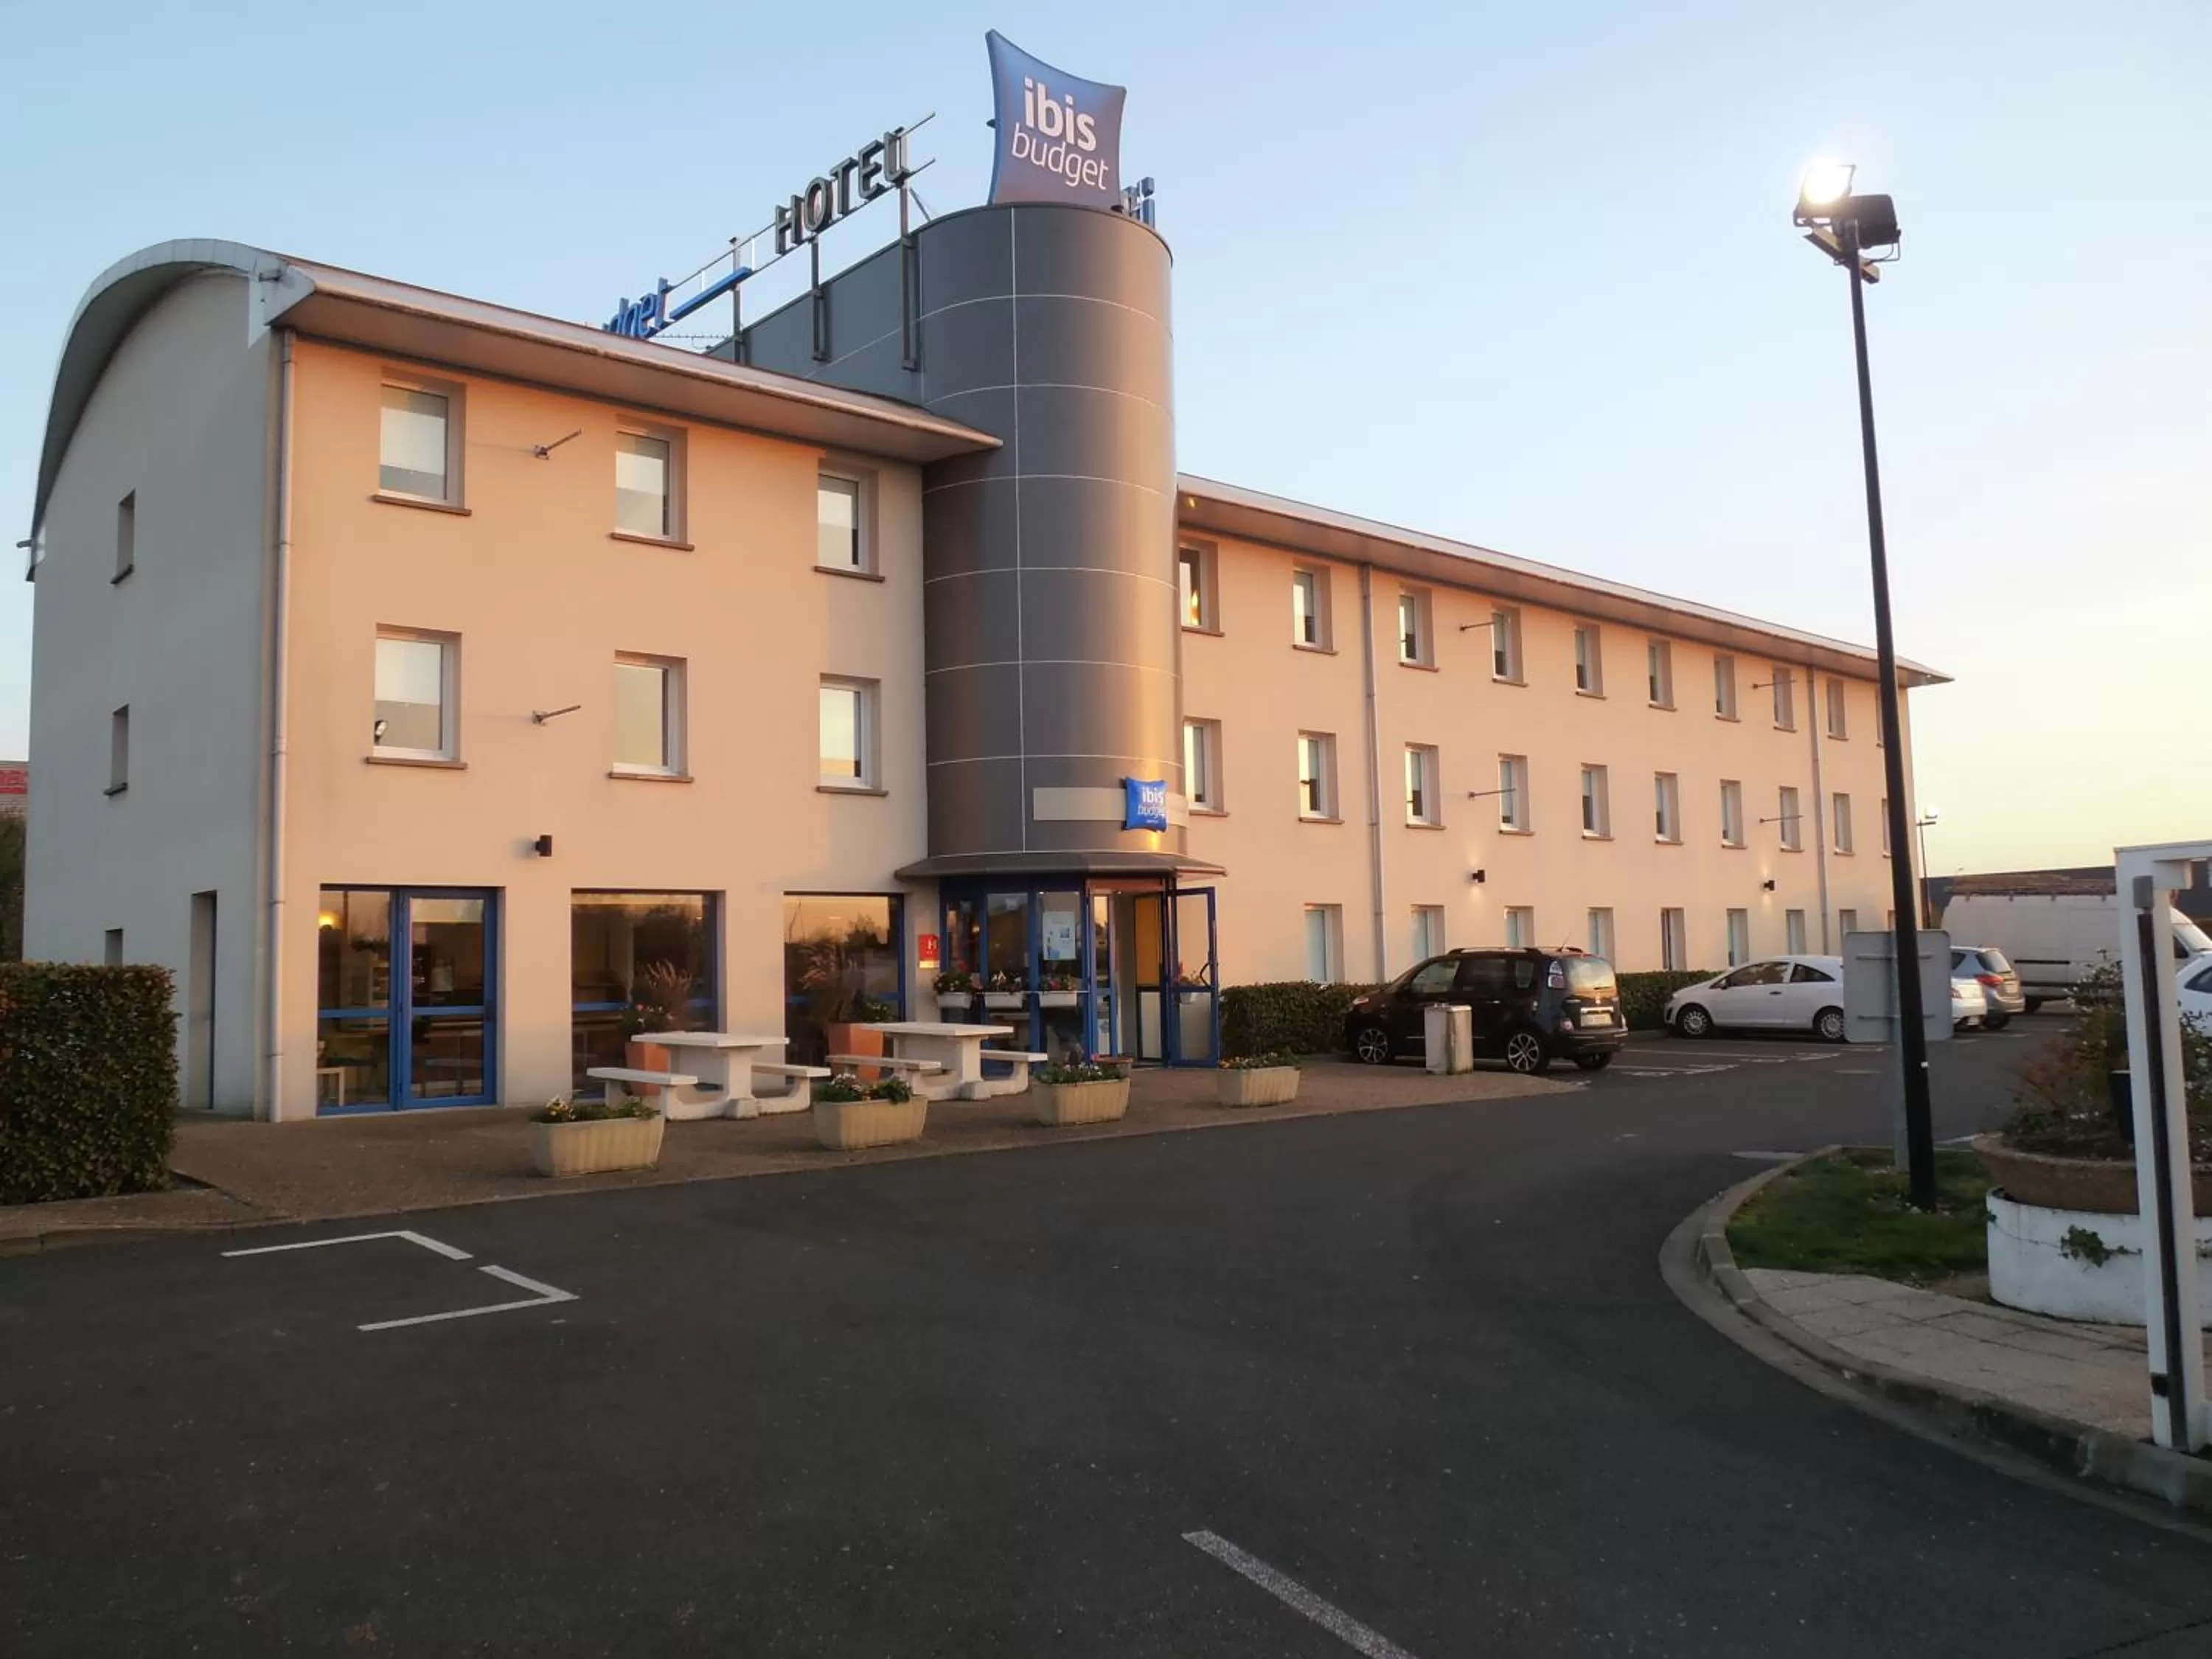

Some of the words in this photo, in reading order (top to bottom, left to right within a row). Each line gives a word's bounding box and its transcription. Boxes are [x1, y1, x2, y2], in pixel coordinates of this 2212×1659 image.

[1024, 76, 1097, 152] ibis
[1011, 122, 1109, 190] budget
[775, 129, 909, 257] HOTEL
[1141, 786, 1164, 804] ibis
